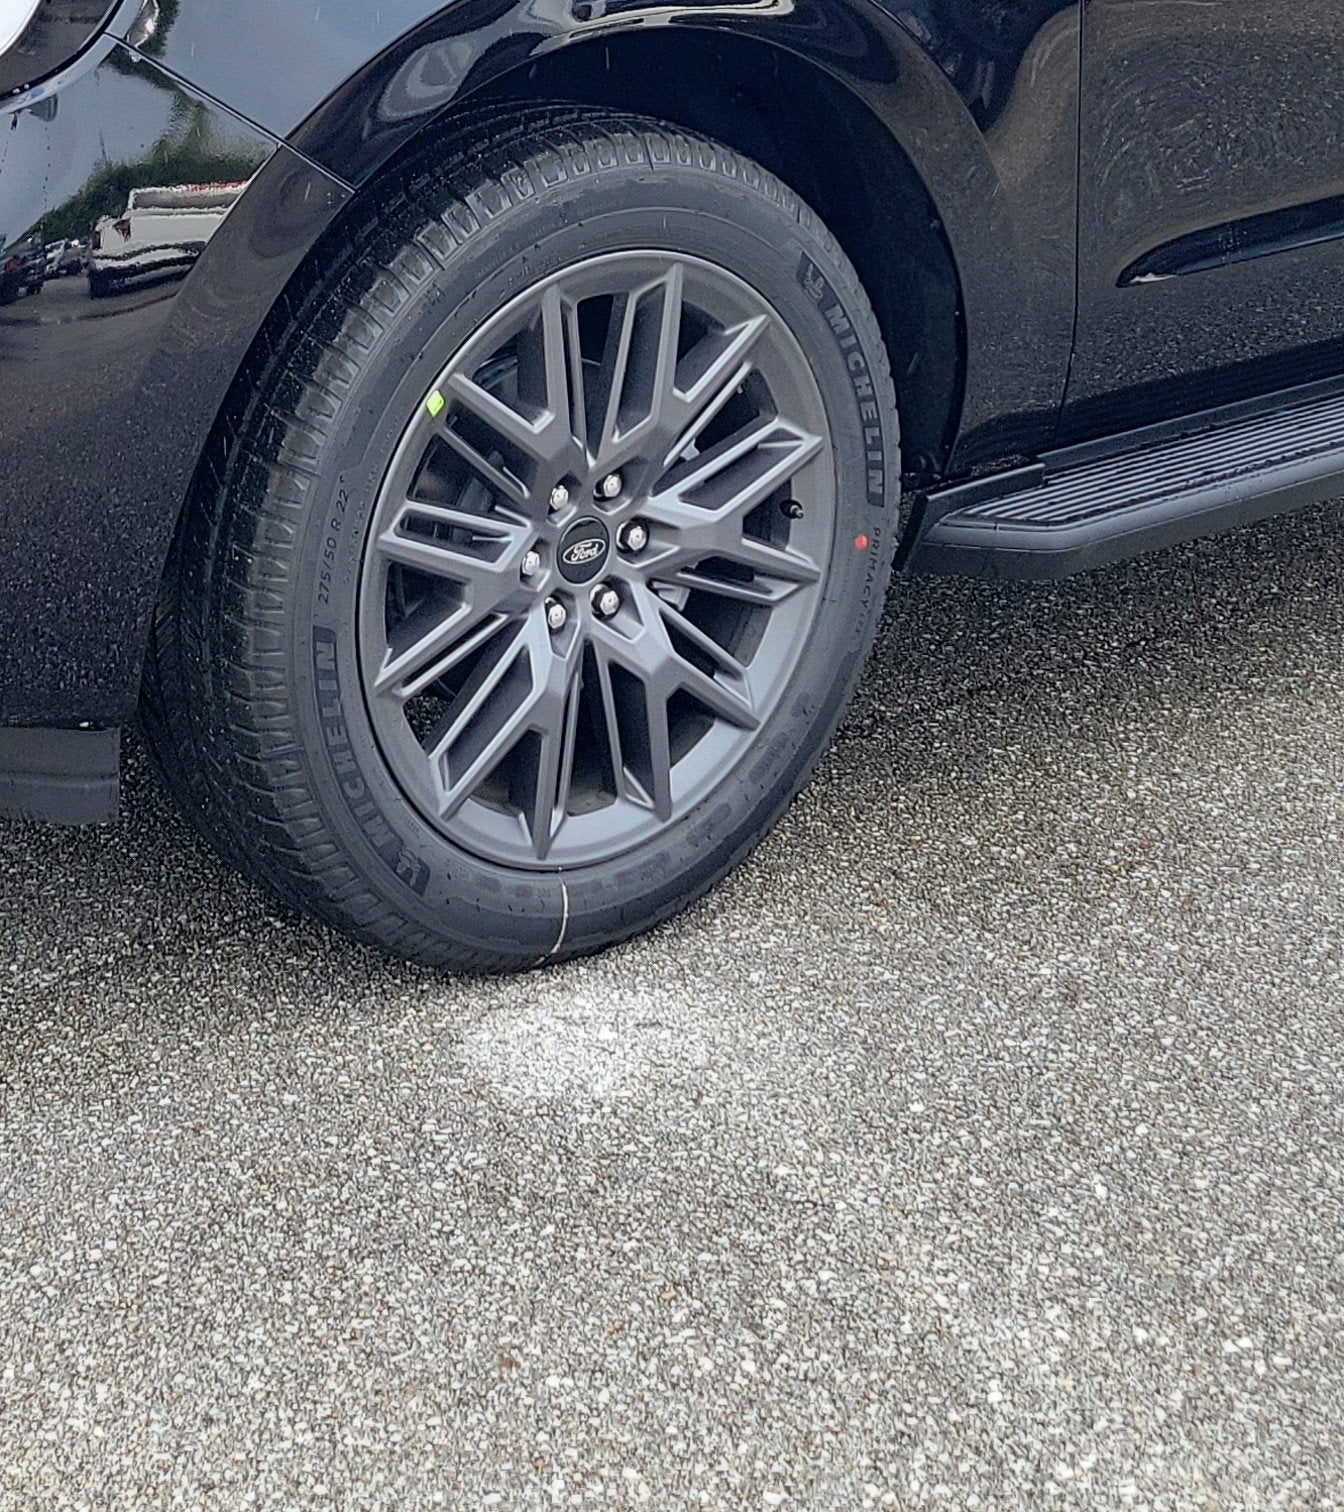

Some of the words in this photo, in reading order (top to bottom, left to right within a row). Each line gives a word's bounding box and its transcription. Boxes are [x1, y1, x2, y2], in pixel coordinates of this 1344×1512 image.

[823, 302, 885, 495] MICHELIN
[570, 541, 600, 562] Ford
[314, 641, 397, 848] MICHELIN
